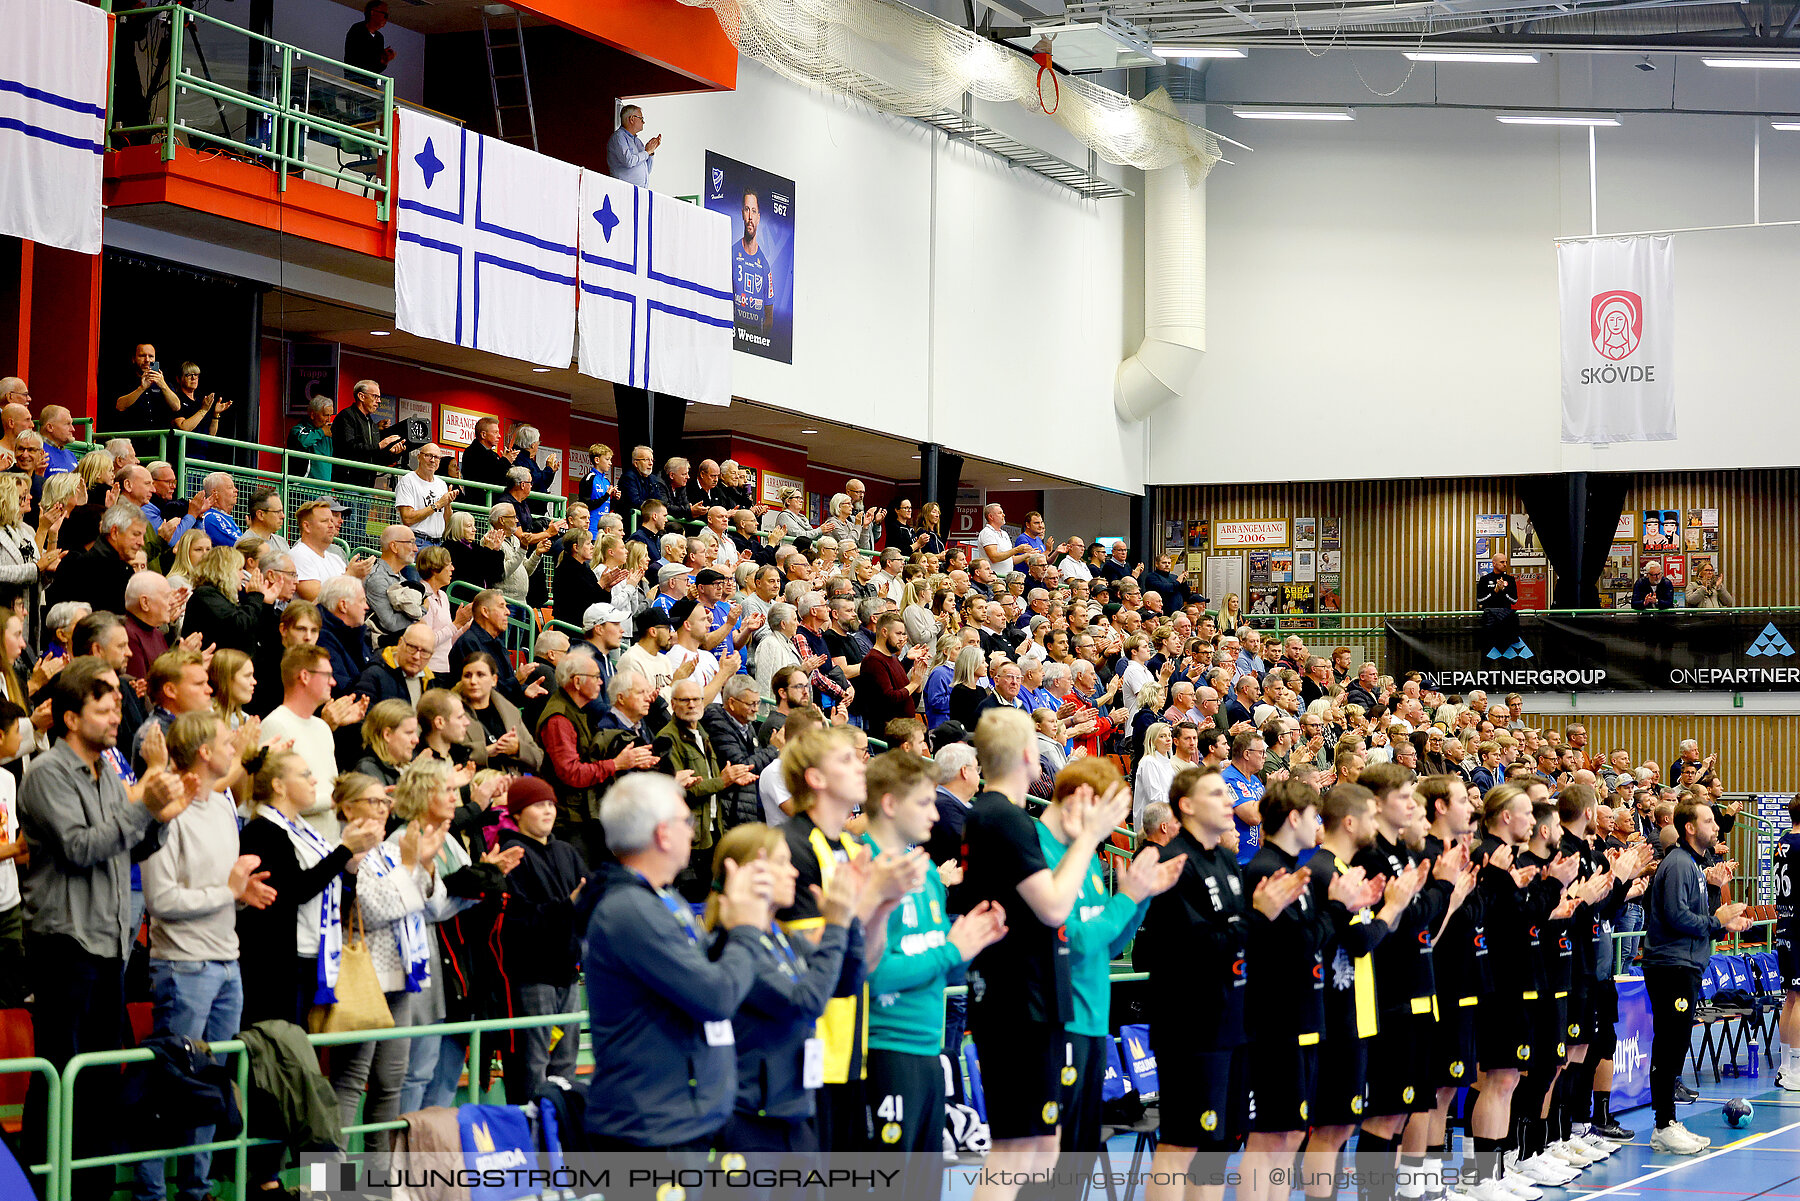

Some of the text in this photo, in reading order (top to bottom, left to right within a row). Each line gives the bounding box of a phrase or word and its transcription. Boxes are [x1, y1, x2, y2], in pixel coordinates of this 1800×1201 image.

[773, 202, 787, 217] 567
[737, 264, 743, 282] 3
[736, 308, 759, 321] VOLVO
[737, 327, 771, 347] Wremer
[1580, 363, 1655, 385] SKÖVDE
[445, 414, 476, 430] ARRANGE
[459, 428, 476, 440] 200
[956, 506, 978, 514] Trappa
[960, 514, 973, 531] D
[1220, 523, 1283, 534] ARRANGEMANG
[1238, 534, 1266, 543] 2006
[1669, 667, 1800, 685] ONEPARTNER
[877, 1094, 904, 1122] 41
